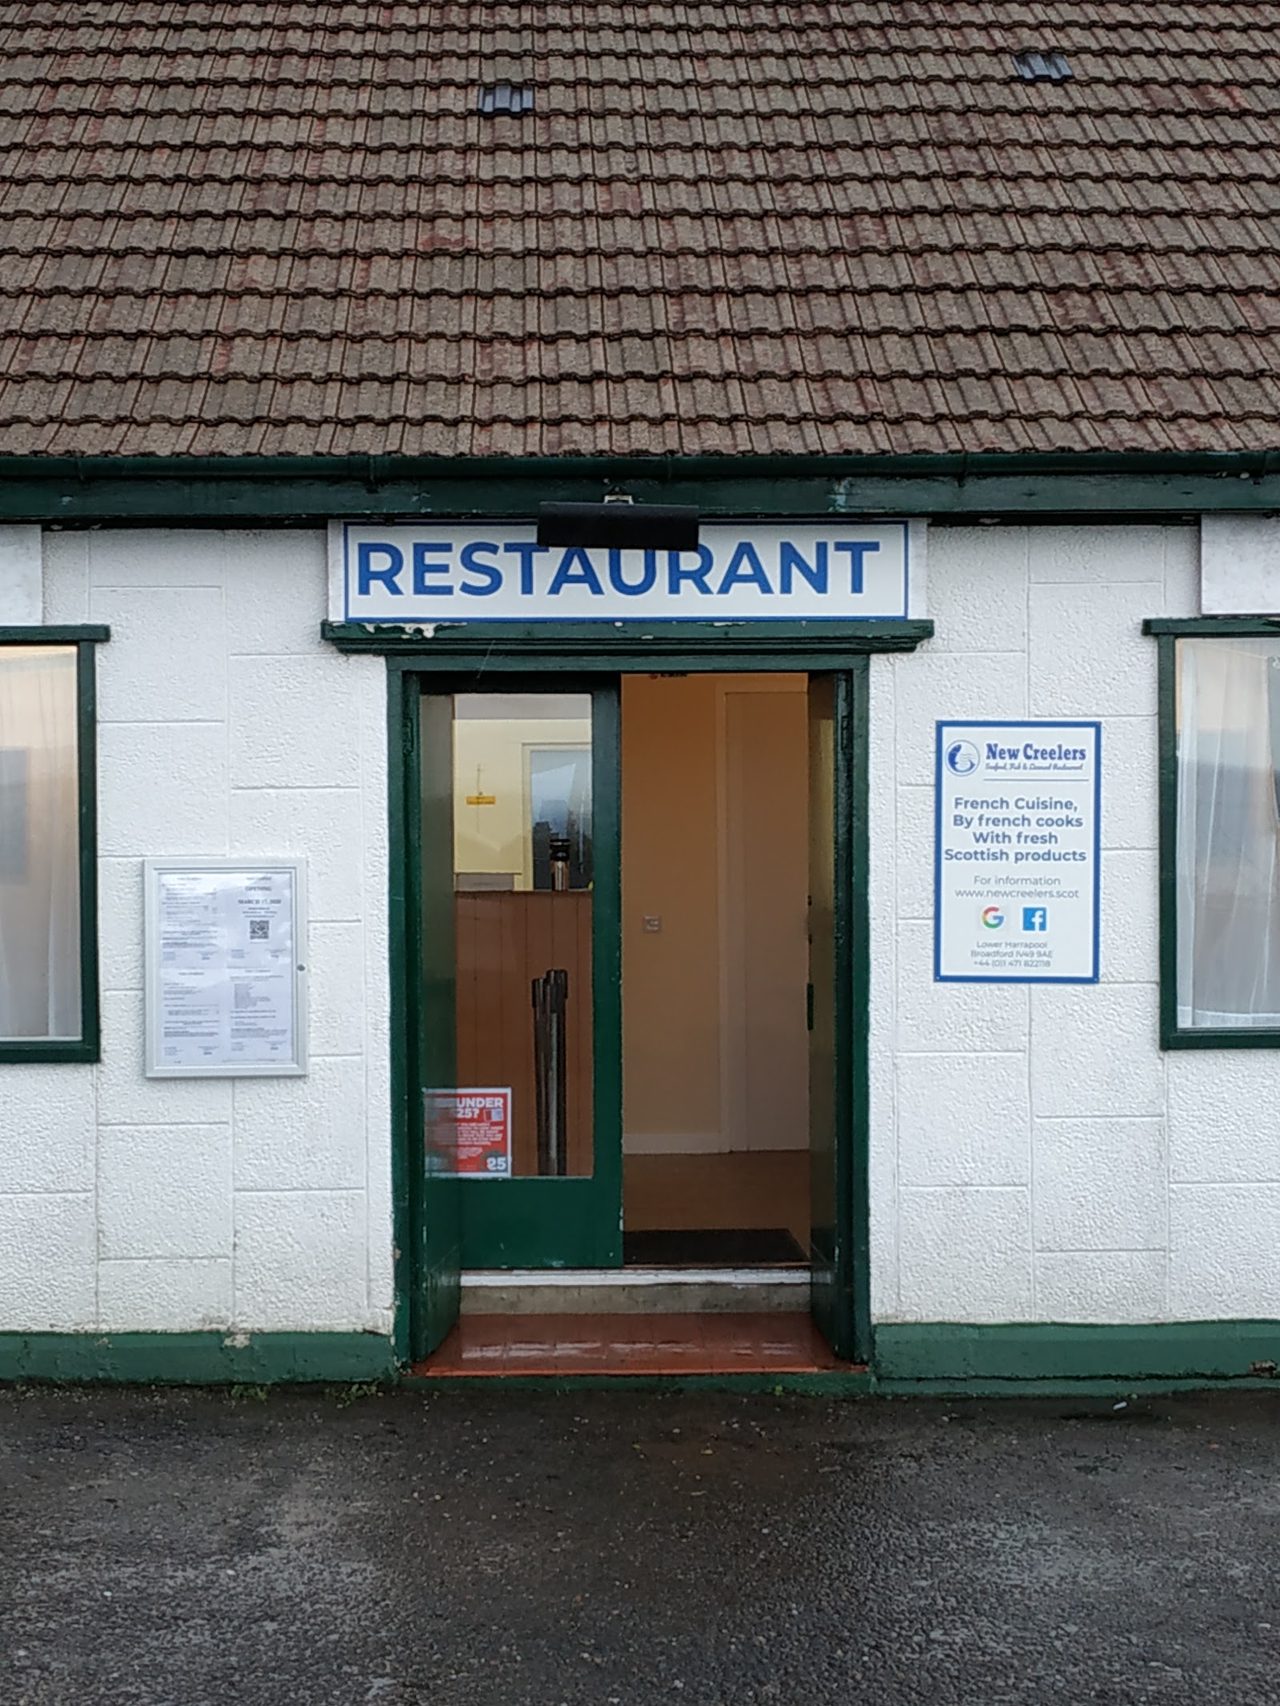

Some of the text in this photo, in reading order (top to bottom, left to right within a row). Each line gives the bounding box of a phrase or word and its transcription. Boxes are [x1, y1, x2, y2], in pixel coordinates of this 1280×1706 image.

[357, 541, 882, 596] RESTAURANT
[986, 743, 1087, 760] New Creelers
[954, 797, 1078, 812] French Cuisine,
[952, 813, 1084, 829] By french cooks
[973, 831, 1059, 845] With fresh
[944, 848, 1087, 864] Scottish products
[973, 875, 1061, 886] For information
[954, 888, 1080, 899] www.newcreelers.scot
[970, 950, 1014, 958] Broadford
[456, 1097, 504, 1108] UNDER
[456, 1108, 480, 1119] 25?
